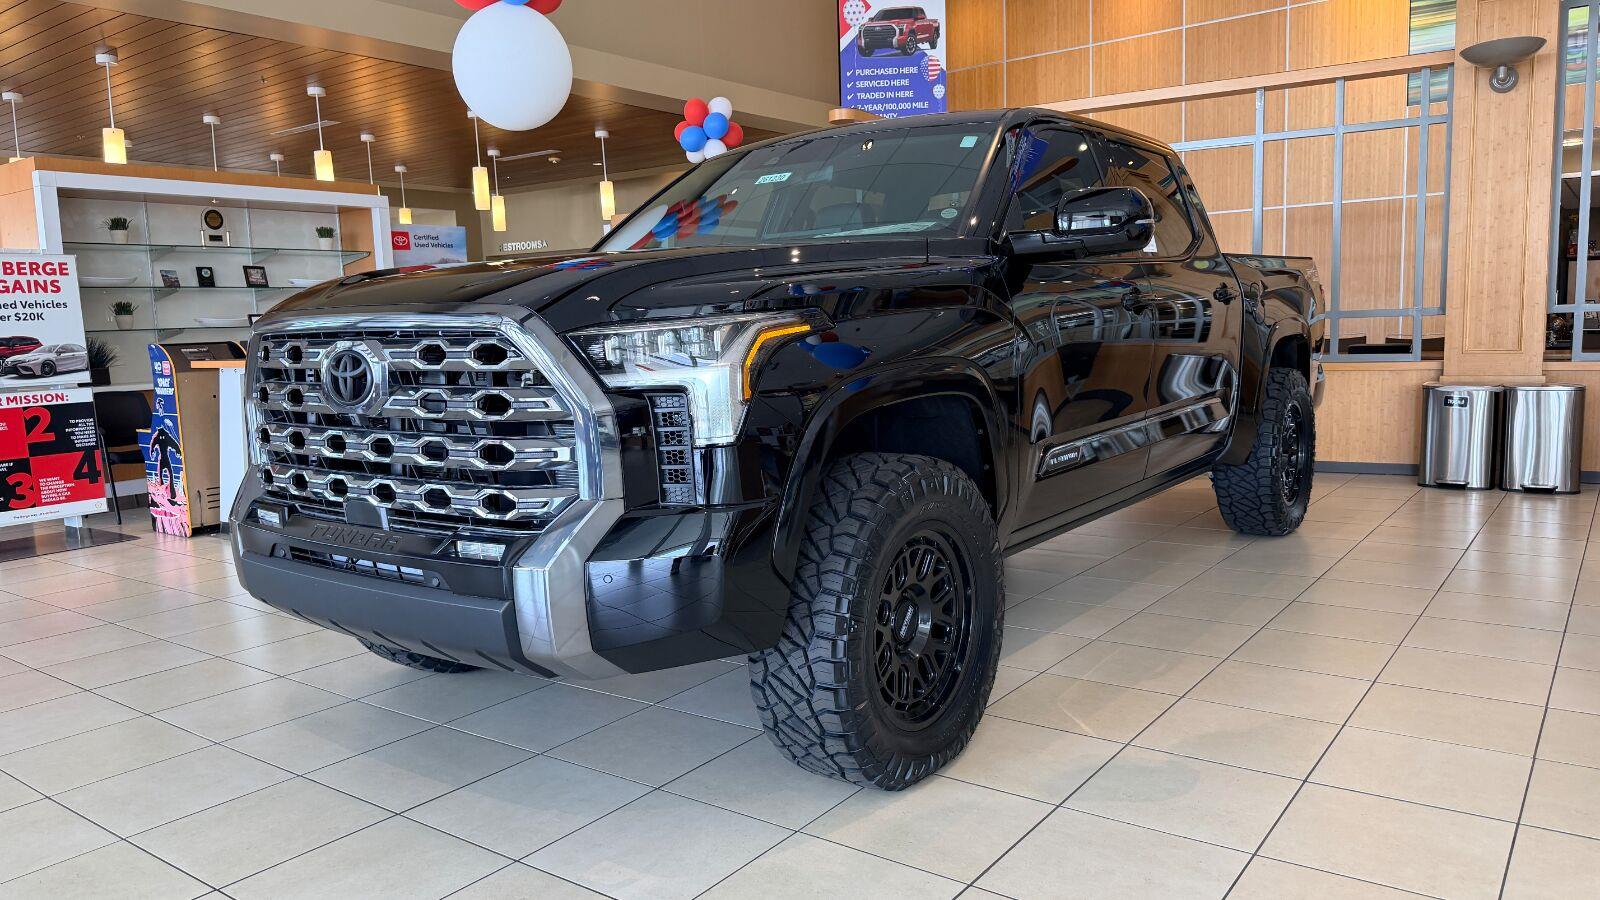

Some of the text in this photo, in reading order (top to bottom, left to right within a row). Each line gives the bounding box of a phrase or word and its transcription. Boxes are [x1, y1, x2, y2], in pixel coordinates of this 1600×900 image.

[856, 68, 898, 76] PURCHASED
[2, 261, 69, 276] BERGE
[20, 300, 68, 309] Vehicles
[15, 312, 44, 322] $20K
[6, 392, 69, 406] MISSION:
[23, 406, 55, 442] 2
[73, 449, 101, 484] 4
[6, 472, 35, 509] 3
[310, 523, 402, 550] TUNDRA
